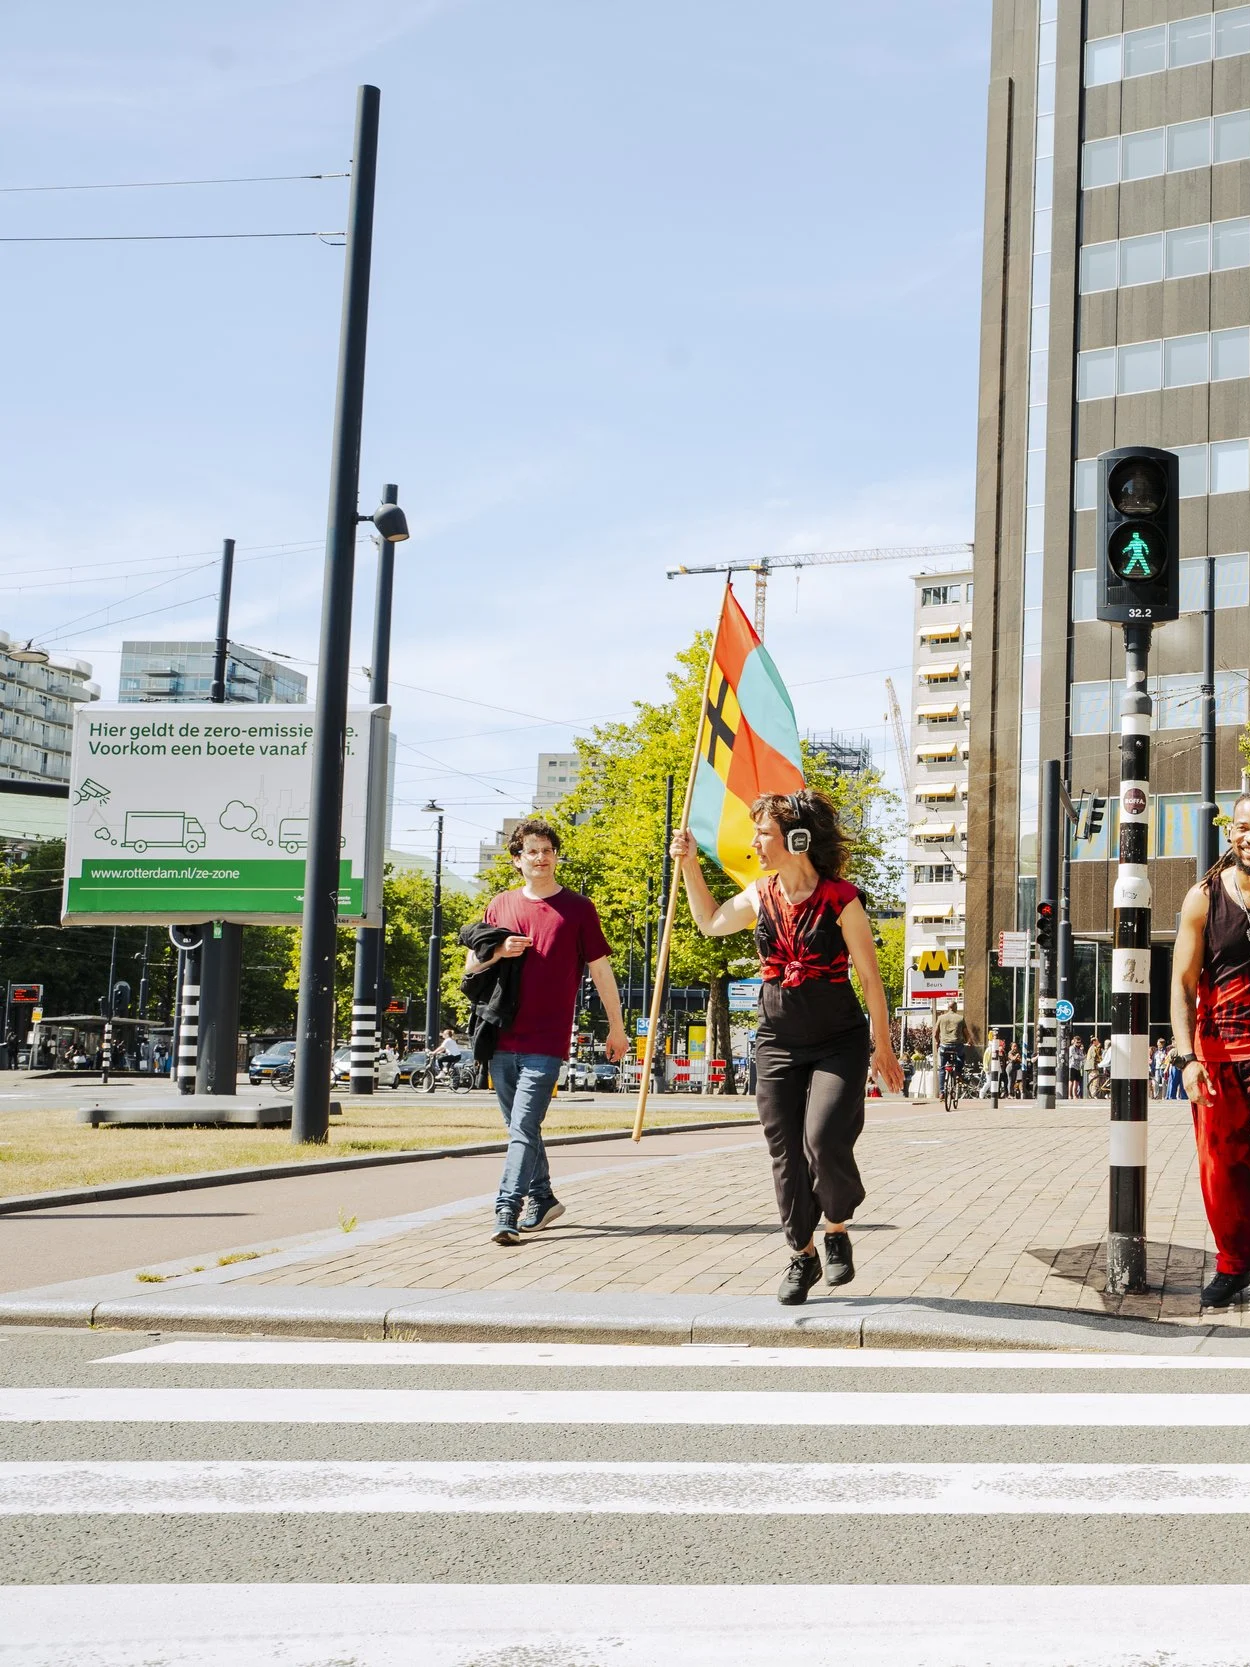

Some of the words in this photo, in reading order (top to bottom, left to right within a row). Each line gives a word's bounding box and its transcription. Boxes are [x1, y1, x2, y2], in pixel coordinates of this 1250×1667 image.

[1128, 608, 1152, 618] 32.2
[90, 722, 127, 737] Hier
[129, 722, 175, 740] geldt
[178, 723, 200, 737] de
[203, 723, 314, 738] zero-emissie
[89, 741, 167, 756] Voorkom
[170, 744, 202, 756] een
[206, 741, 255, 756] boete
[259, 741, 308, 756] vanaf
[91, 867, 240, 879] www.rotterdam.nl/ze-zone
